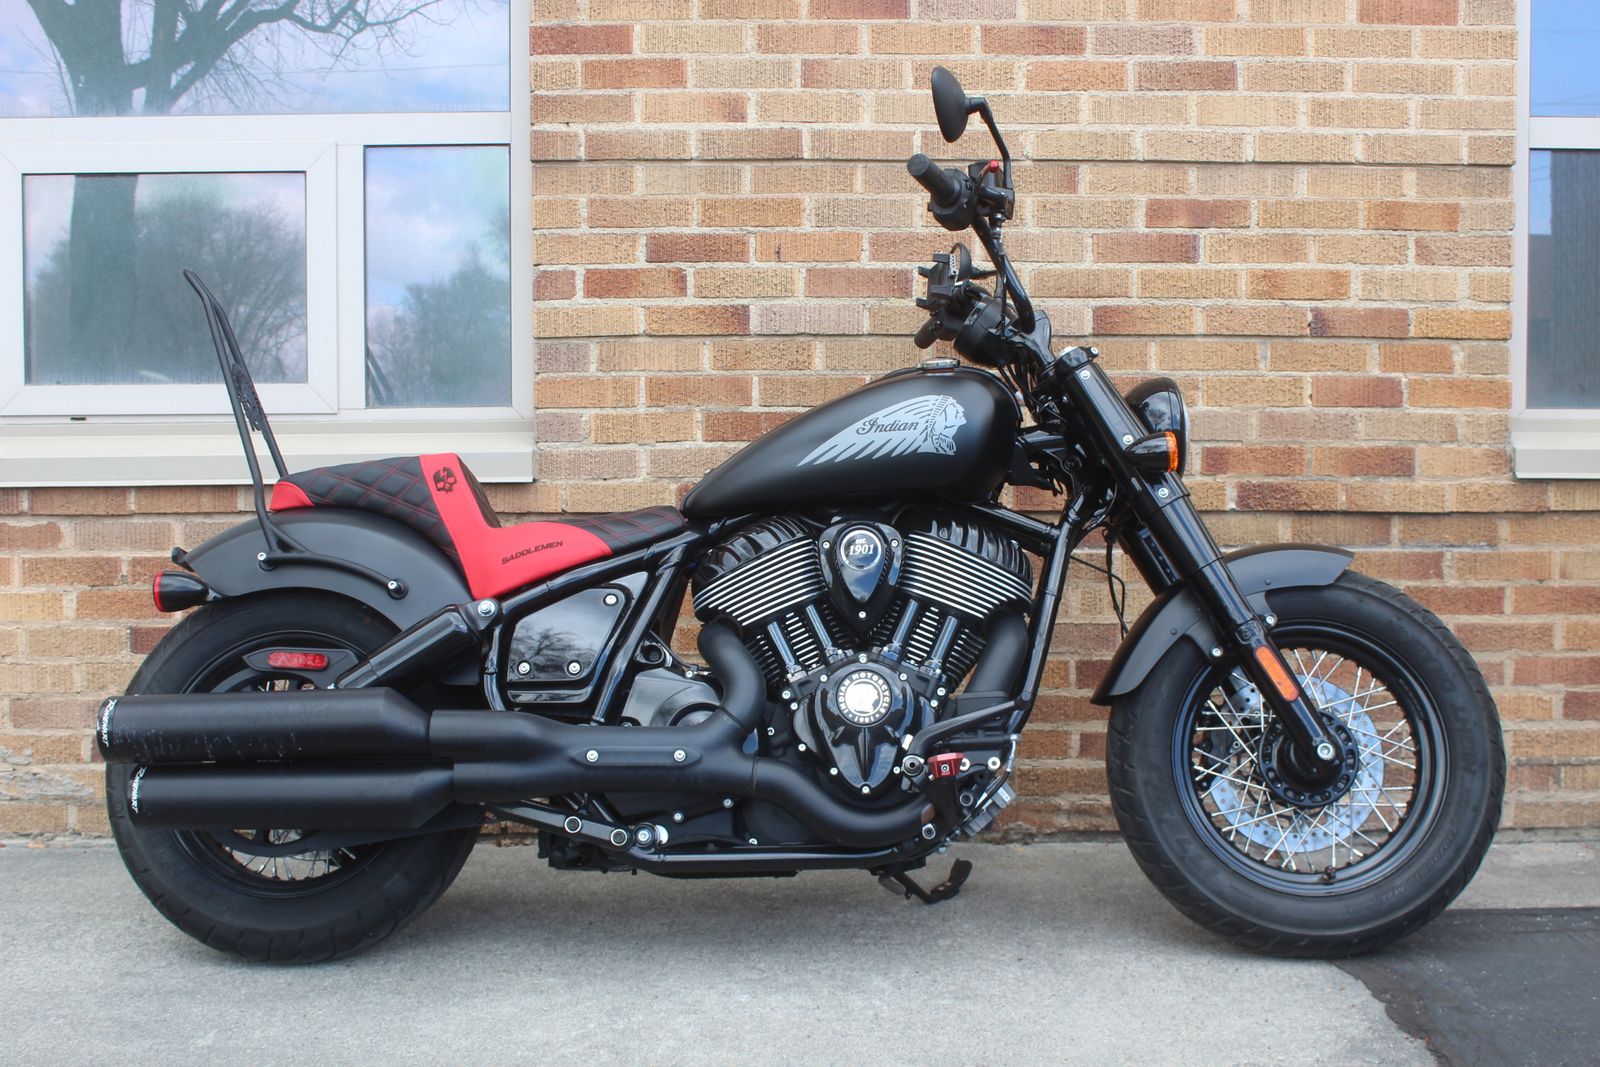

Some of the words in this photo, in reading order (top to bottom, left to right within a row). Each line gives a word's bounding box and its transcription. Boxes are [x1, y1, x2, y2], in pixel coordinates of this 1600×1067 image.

[856, 418, 919, 435] Indian
[501, 540, 563, 565] SADDLEMEN
[849, 543, 874, 555] 1901
[838, 679, 851, 714] INDIAN
[851, 672, 890, 714] MOTORCYCLE
